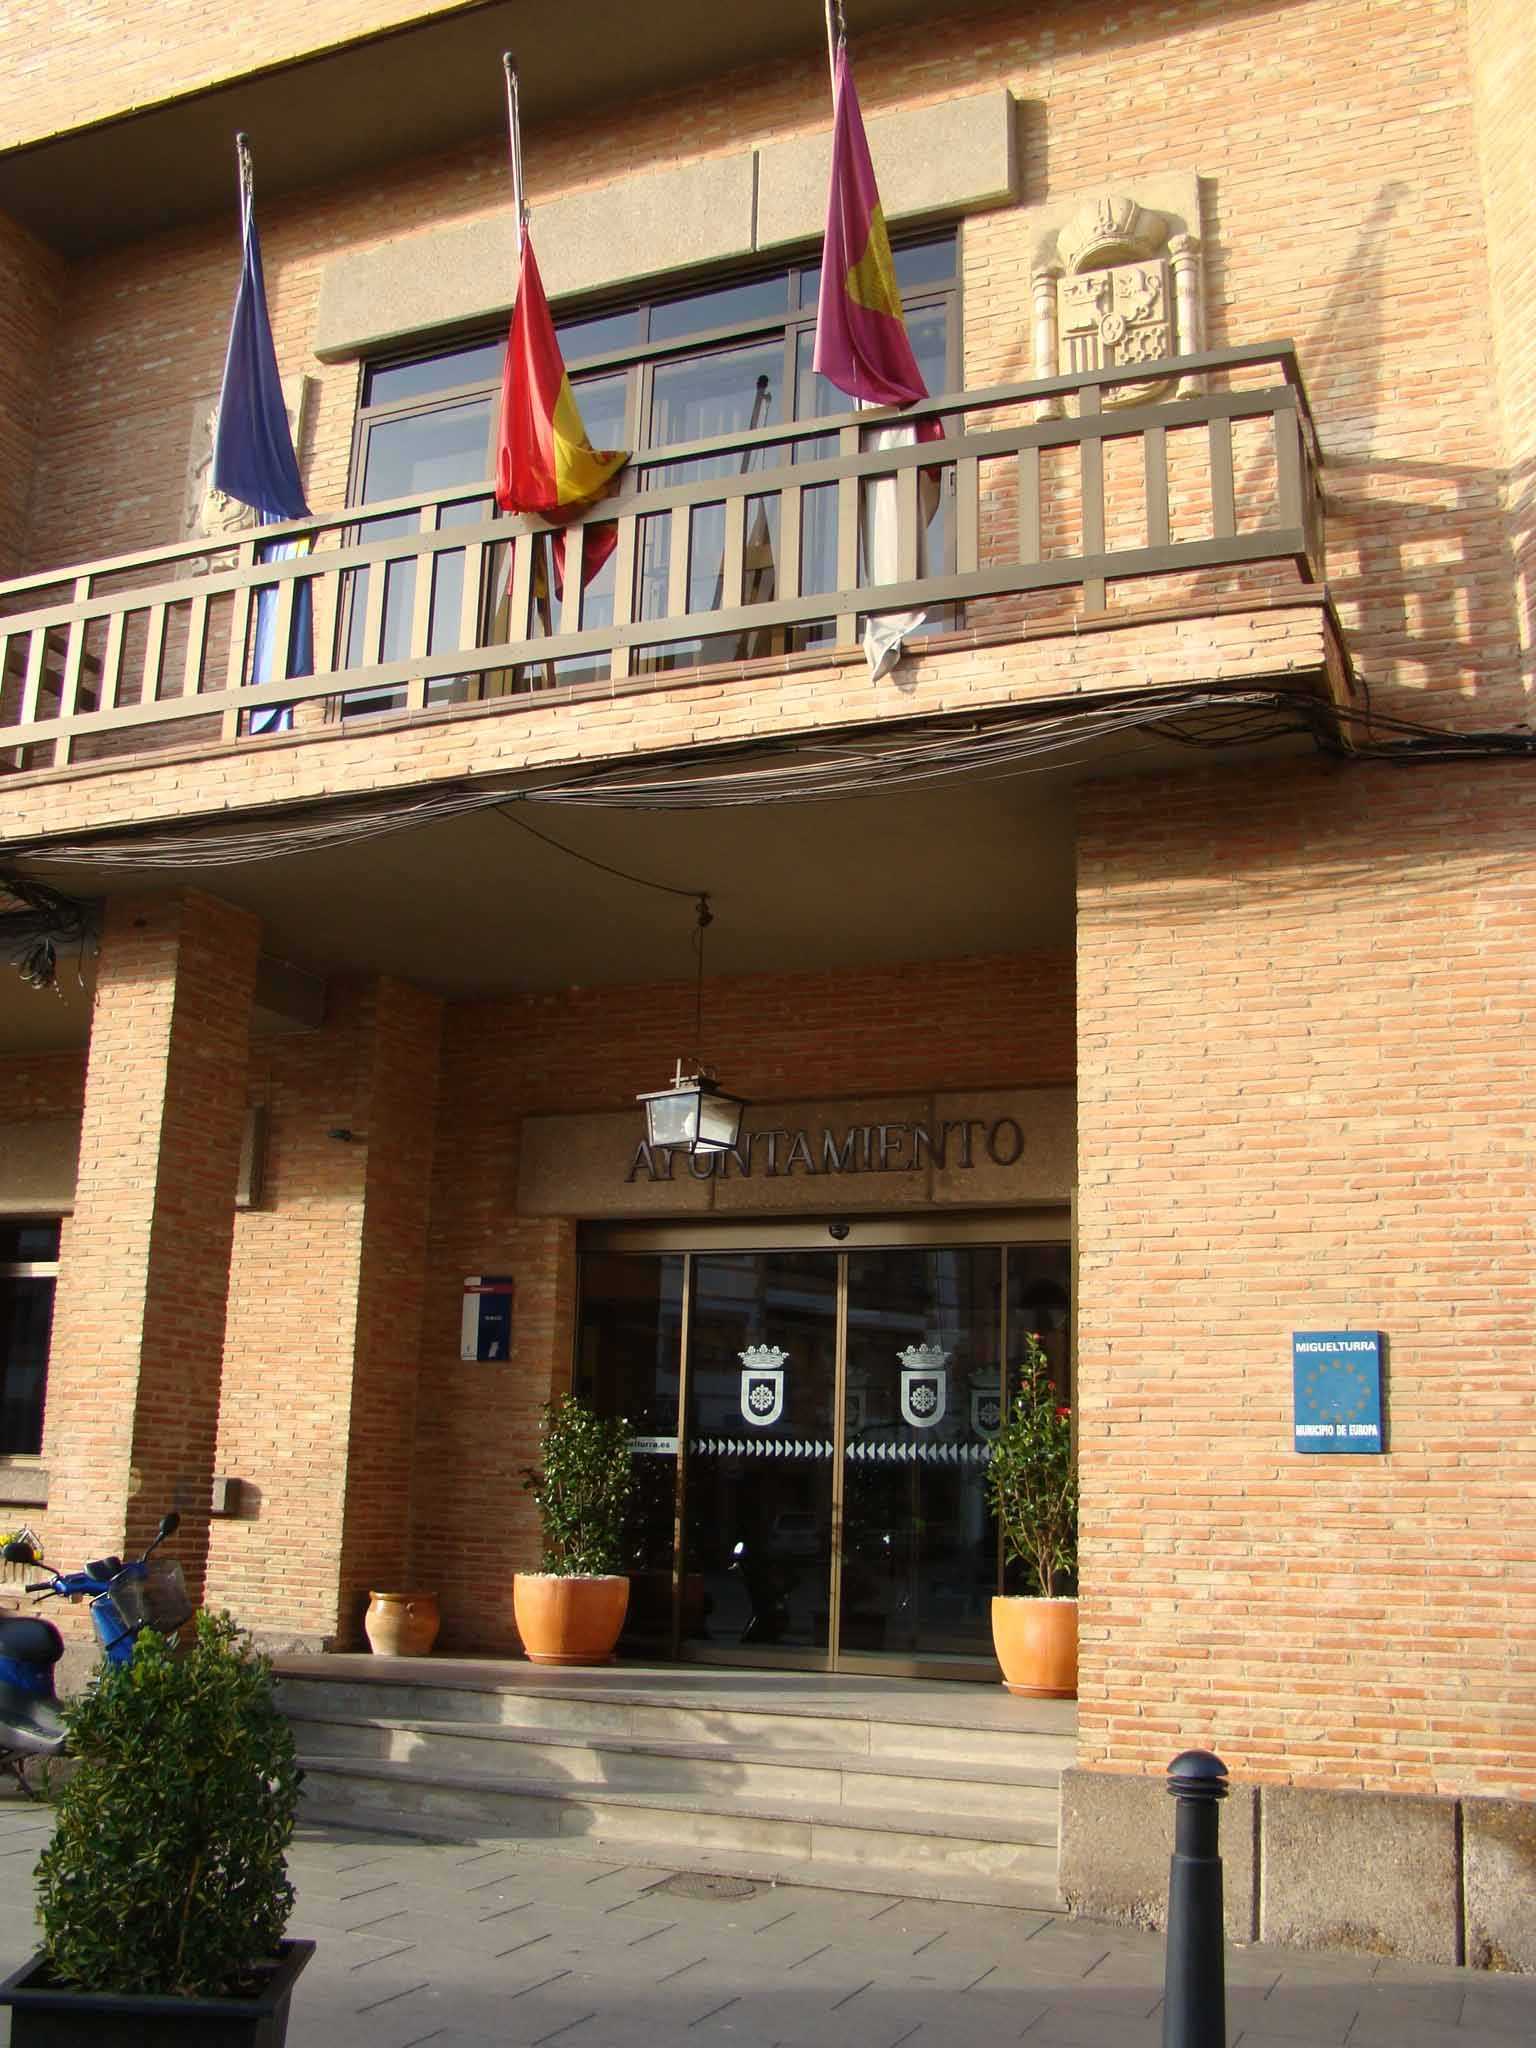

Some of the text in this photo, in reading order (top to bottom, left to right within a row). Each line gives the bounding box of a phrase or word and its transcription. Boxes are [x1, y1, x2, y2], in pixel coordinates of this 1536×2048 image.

[624, 1118, 1025, 1183] AYUNTAMIENTO
[1296, 1341, 1376, 1352] MIGUELTURRA
[1336, 1424, 1347, 1436] DE
[1349, 1424, 1377, 1436] EUROPA
